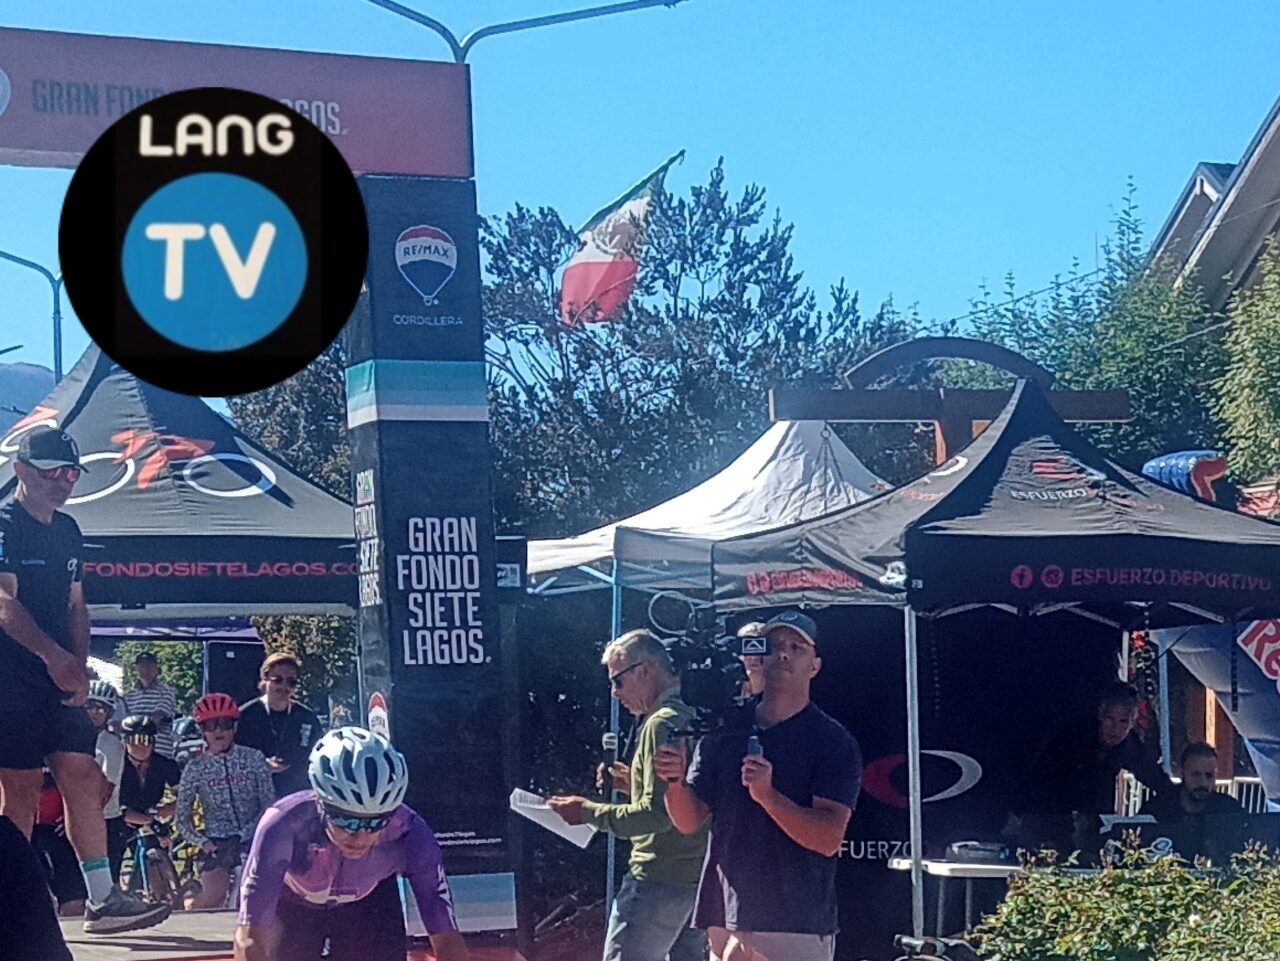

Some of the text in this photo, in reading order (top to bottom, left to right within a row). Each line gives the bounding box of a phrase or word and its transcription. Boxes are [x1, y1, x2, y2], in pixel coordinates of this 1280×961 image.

[403, 244, 449, 259] RE/MAX
[392, 314, 464, 326] CORDILLERA
[408, 516, 478, 553] GRAN
[396, 554, 480, 590] FONDO
[1071, 567, 1166, 586] ESFUERZO
[408, 592, 482, 628] SIETE
[402, 629, 492, 665] LAGOS.
